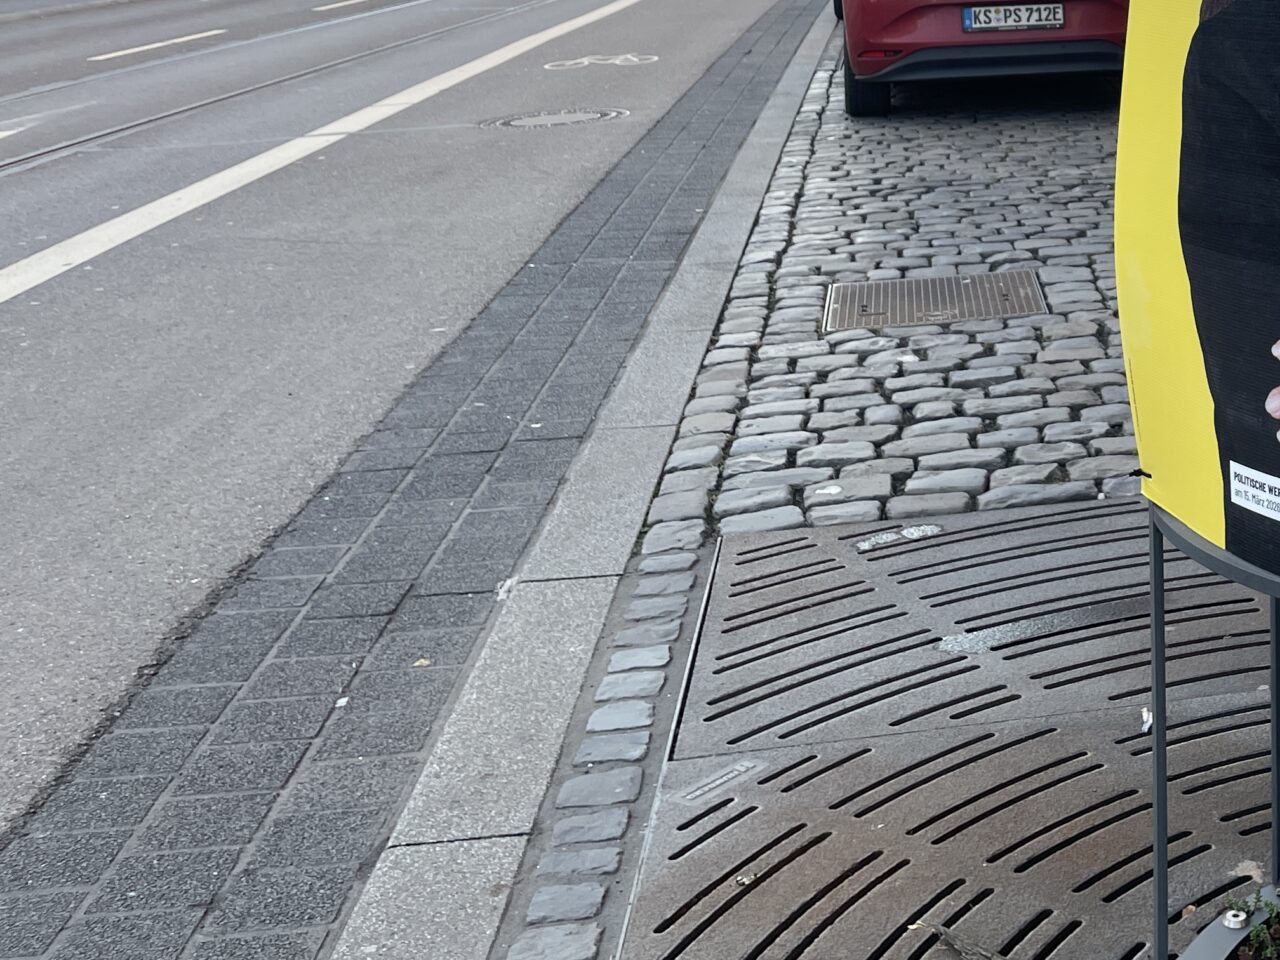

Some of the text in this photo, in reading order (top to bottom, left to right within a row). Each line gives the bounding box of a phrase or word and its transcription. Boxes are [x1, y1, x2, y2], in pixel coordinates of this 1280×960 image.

[973, 5, 1061, 25] KS PS 712E
[1233, 471, 1267, 493] POLITISCHE
[1234, 488, 1243, 499] am
[1251, 493, 1265, 507] März
